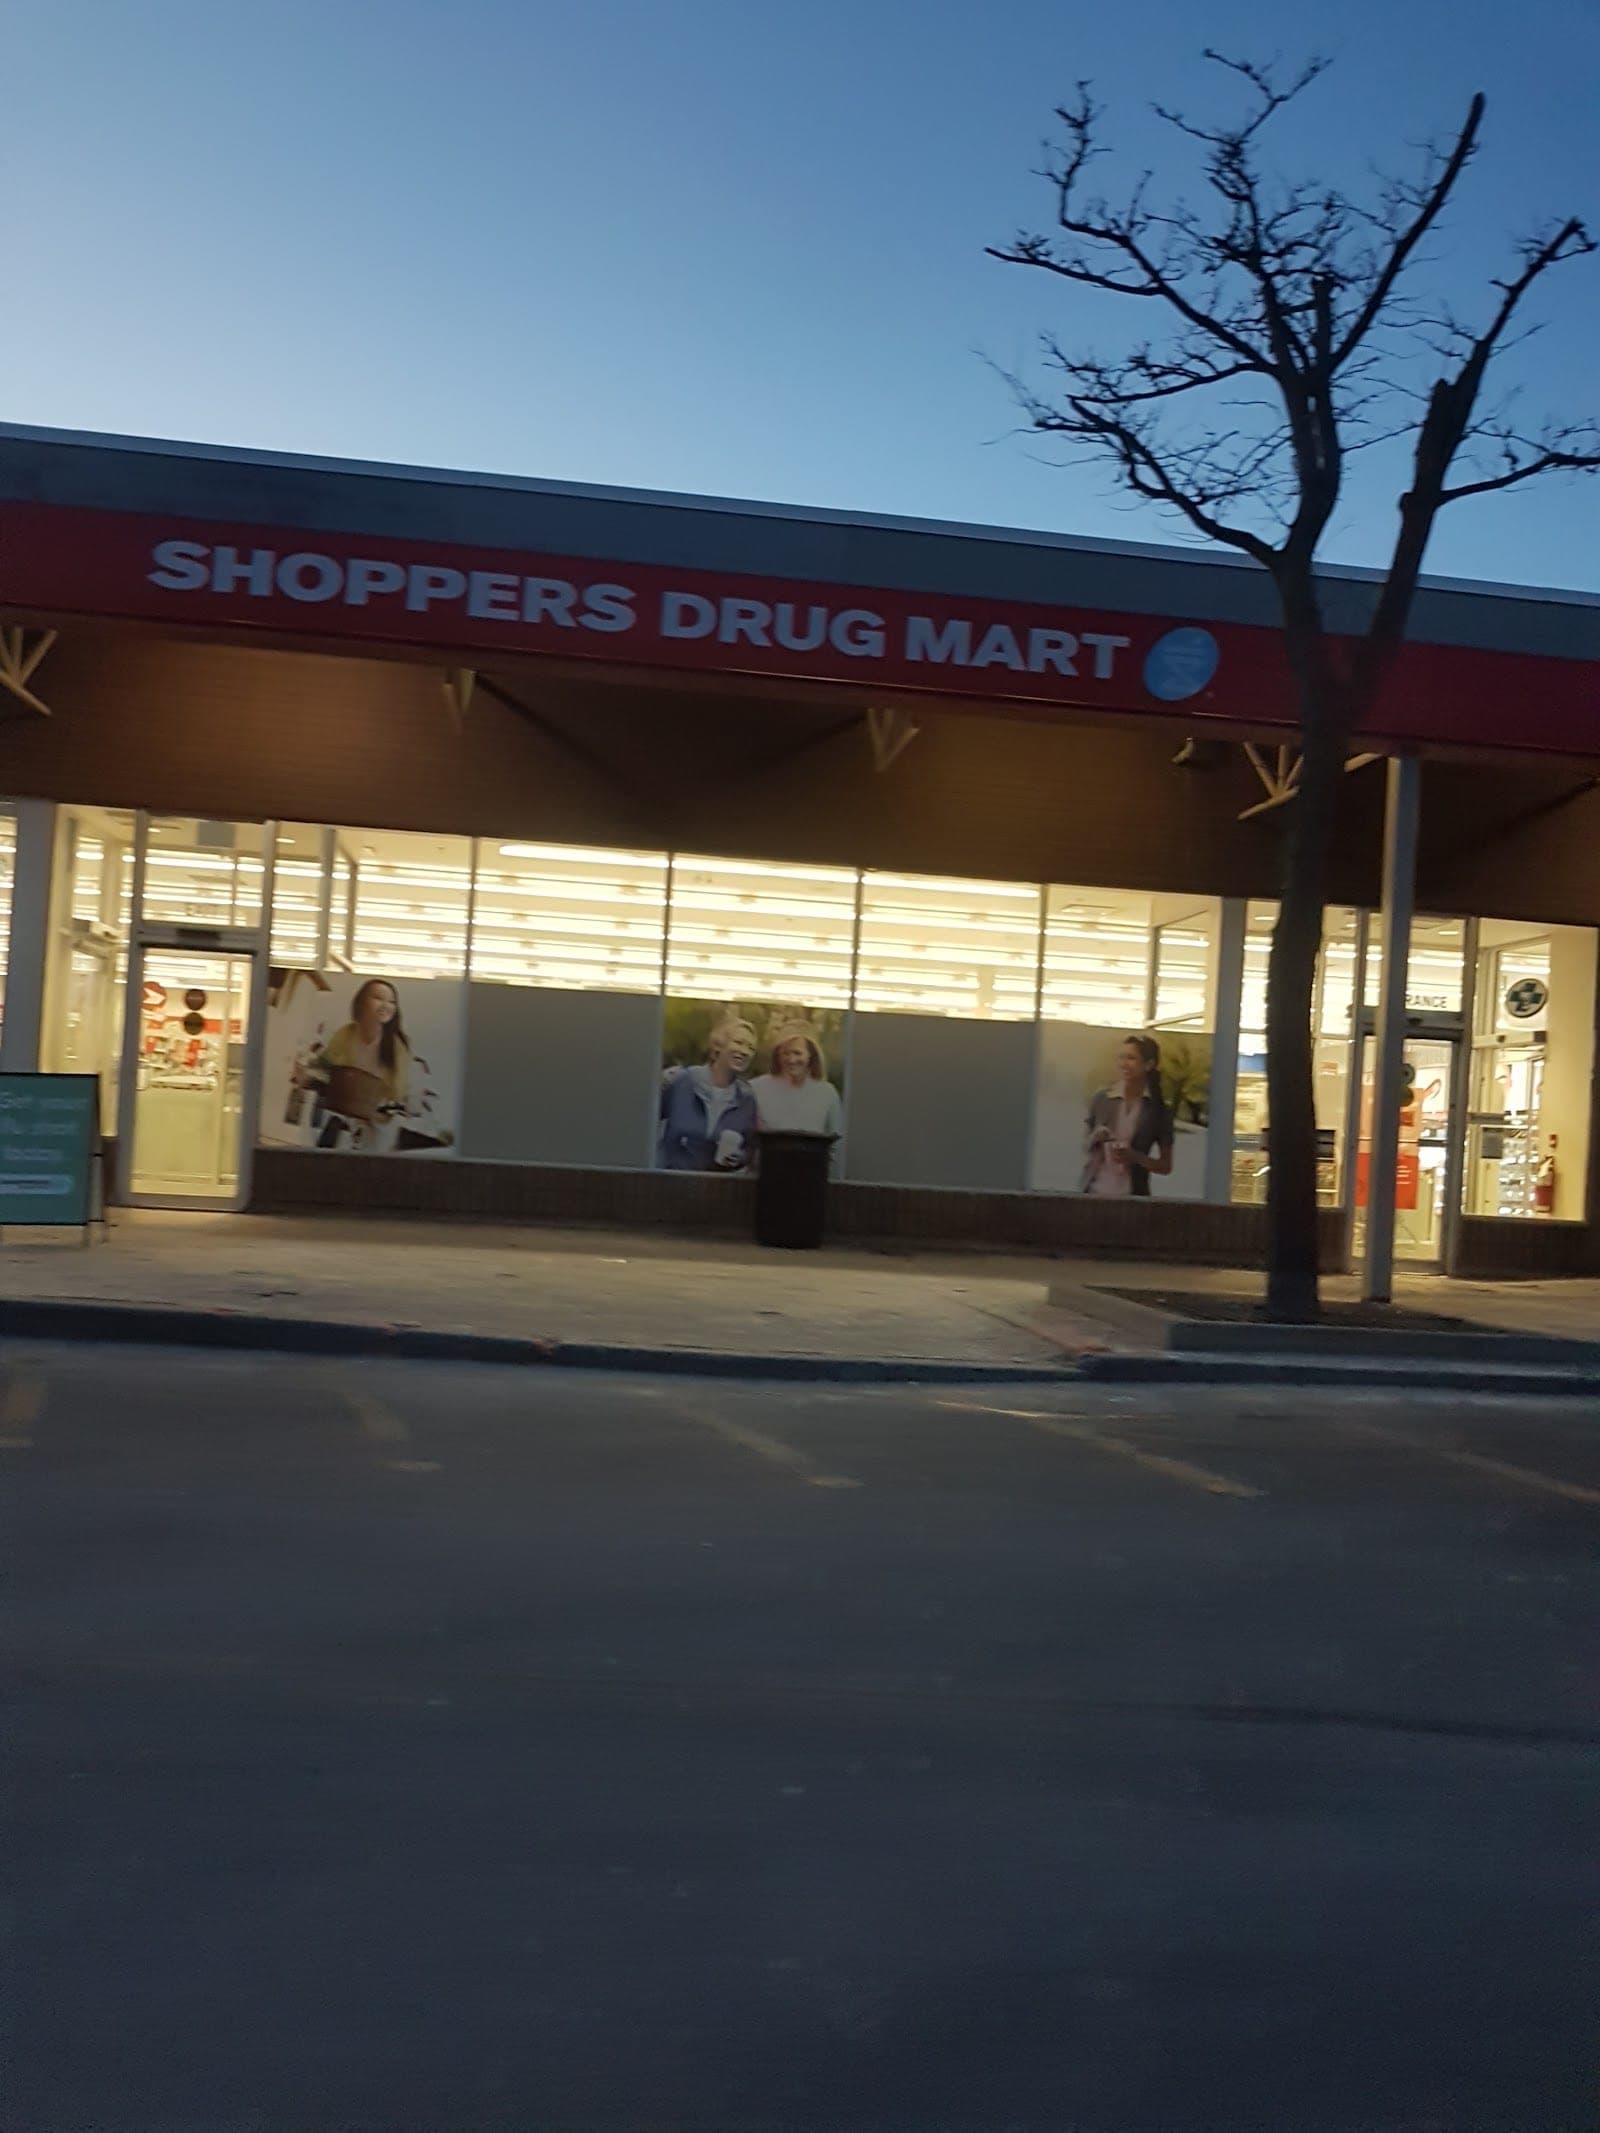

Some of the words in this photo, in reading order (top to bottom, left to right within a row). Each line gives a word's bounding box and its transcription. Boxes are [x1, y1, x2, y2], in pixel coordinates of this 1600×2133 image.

[147, 540, 637, 634] SHOPPERS
[660, 591, 888, 658] DRUG
[905, 616, 1131, 680] MART
